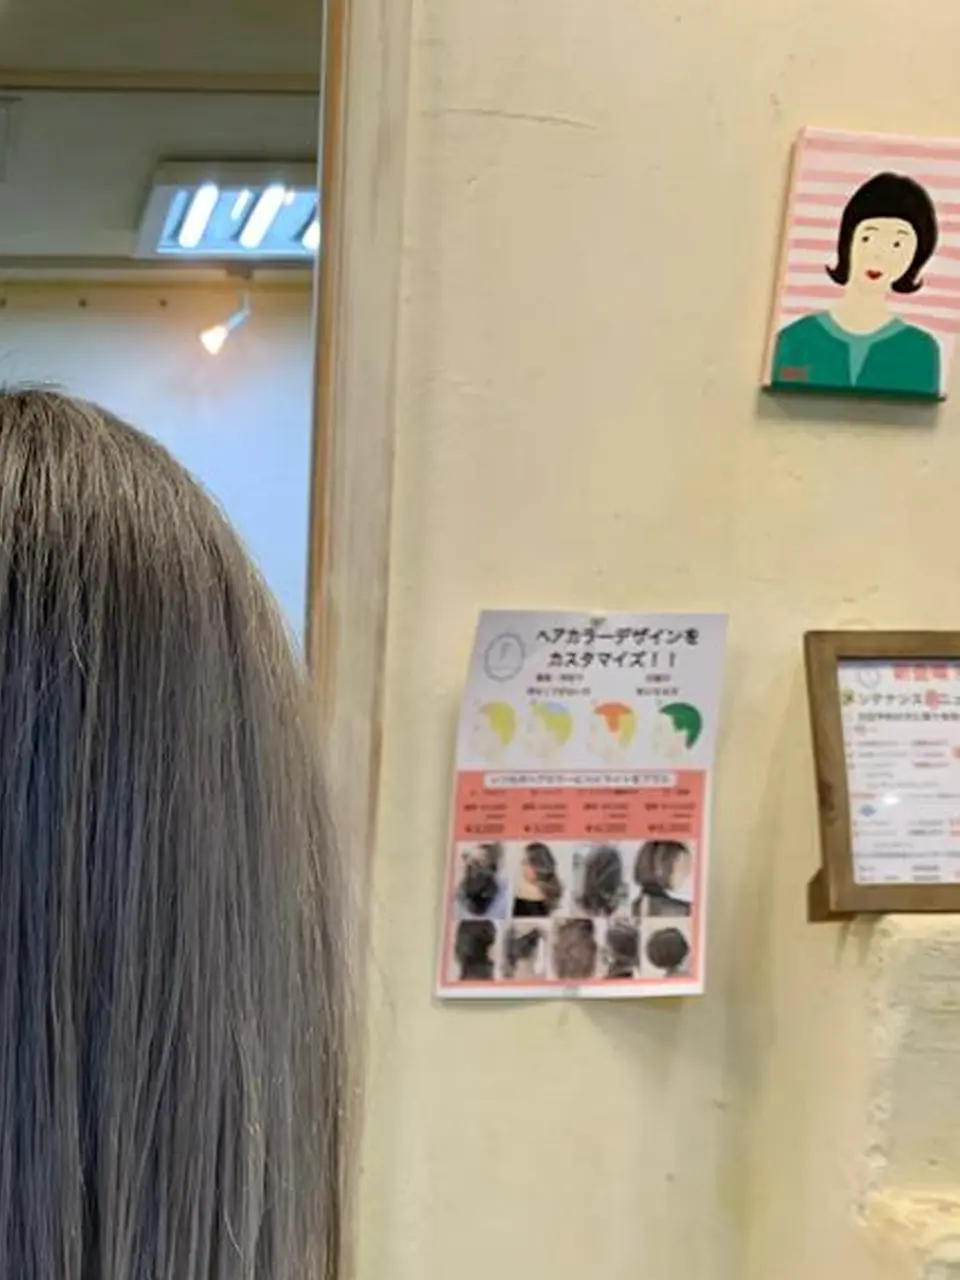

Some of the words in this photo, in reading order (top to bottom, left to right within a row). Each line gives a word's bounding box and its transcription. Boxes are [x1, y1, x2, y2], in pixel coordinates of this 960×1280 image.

[536, 627, 700, 646] ヘアカラーデザインを
